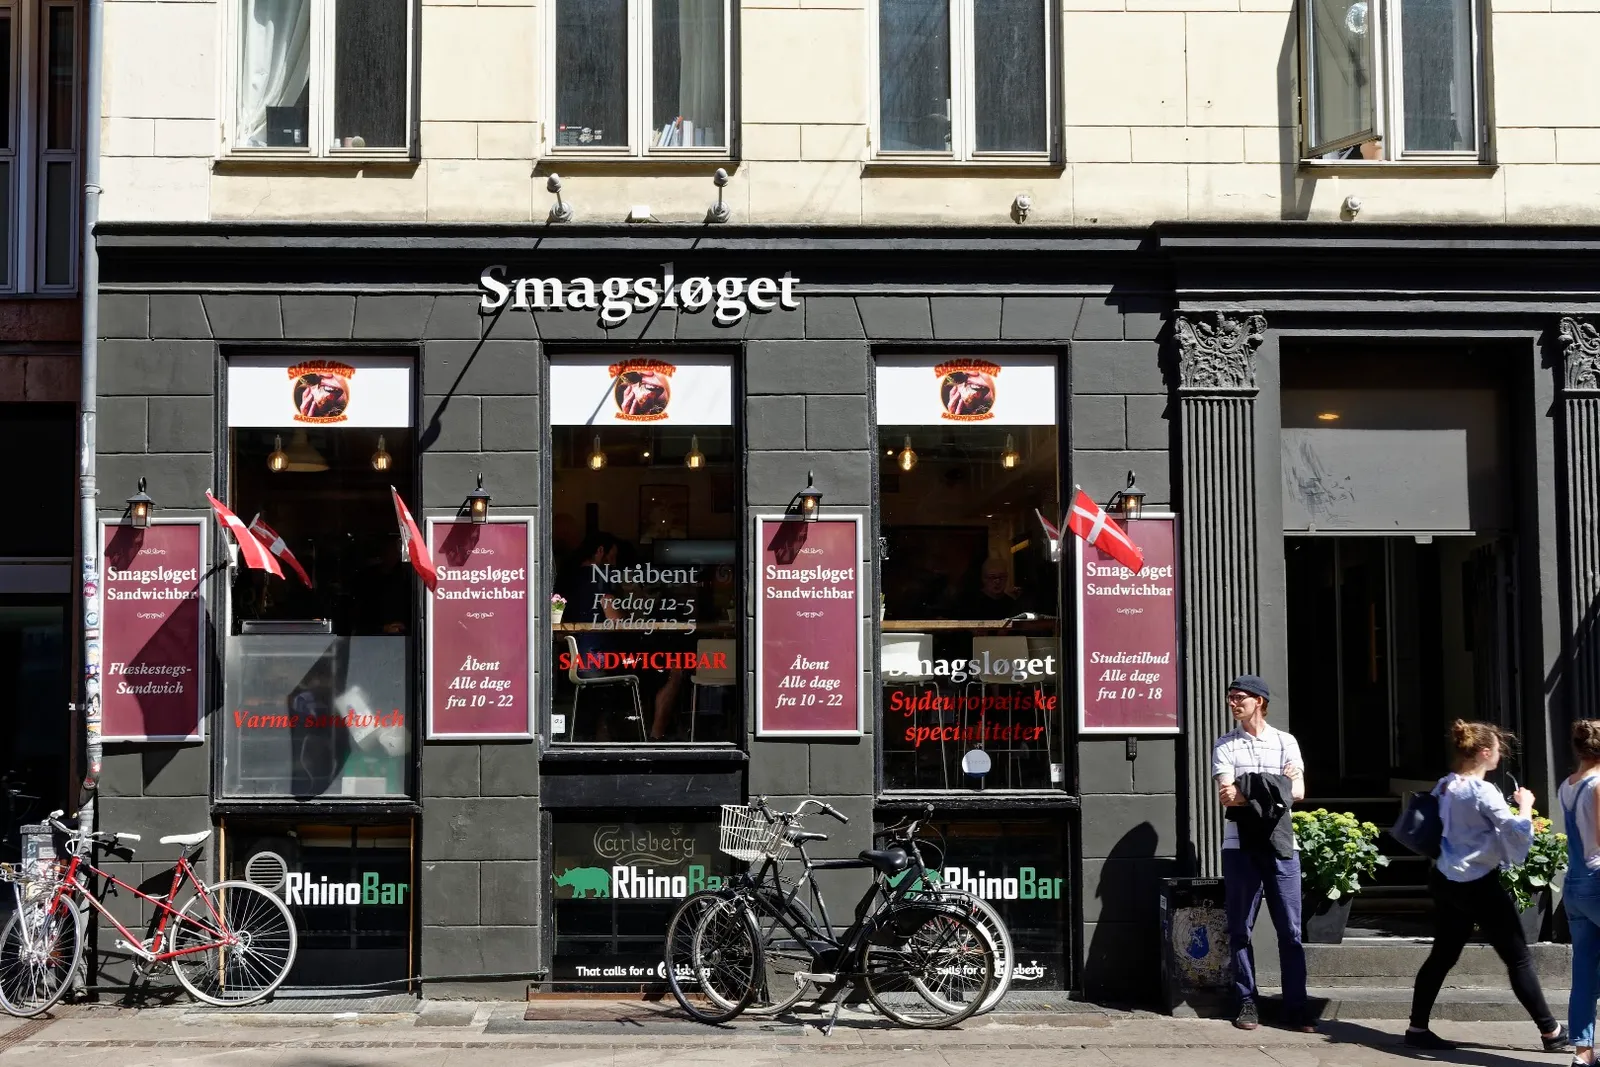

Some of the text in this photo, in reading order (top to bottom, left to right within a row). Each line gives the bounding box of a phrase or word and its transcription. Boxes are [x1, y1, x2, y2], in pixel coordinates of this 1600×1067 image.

[480, 262, 800, 321] Smagsløget
[107, 566, 197, 584] Smagsløget
[436, 565, 525, 583] Smagsløget
[590, 563, 698, 584] Natåbent
[766, 564, 854, 583] Smagsløget
[1086, 561, 1173, 580] Smagsøget
[107, 588, 197, 600] Sandwichbar
[436, 587, 525, 600] Sandwichbar
[766, 586, 855, 599] Sandwichbar
[1086, 583, 1173, 596] Sandwichbar
[592, 592, 695, 615] Fredag 12-5
[592, 612, 654, 635] Lørdag
[460, 655, 500, 671] Åbent
[559, 652, 728, 670] SANDWICHBAR
[790, 654, 830, 670] Åbent
[1090, 651, 1170, 665] Studietilbud
[108, 662, 192, 678] Flæskestegs-
[1099, 669, 1160, 684] Alle dage
[116, 681, 184, 695] Sandwich
[448, 676, 511, 691] Alle dage
[778, 675, 841, 691] Alle dage
[445, 695, 466, 709] fra
[470, 695, 486, 707] 10
[497, 695, 513, 707] 22
[775, 694, 796, 708] fra
[799, 694, 815, 706] 10
[827, 694, 843, 706] 22
[1096, 687, 1116, 702] fra
[1120, 687, 1136, 700] 10
[1147, 687, 1163, 700] 18
[890, 690, 1057, 717] Sydeuropæiske
[233, 708, 404, 728] Varme sandwich
[905, 720, 1044, 747] specialiteter
[593, 825, 696, 859] Carlsberg
[285, 872, 410, 905] RhinoBar
[944, 867, 1065, 899] RhinoBar
[576, 966, 600, 976] That
[603, 965, 626, 976] calls
[629, 965, 644, 976] for
[647, 967, 653, 976] a
[963, 965, 978, 975] for
